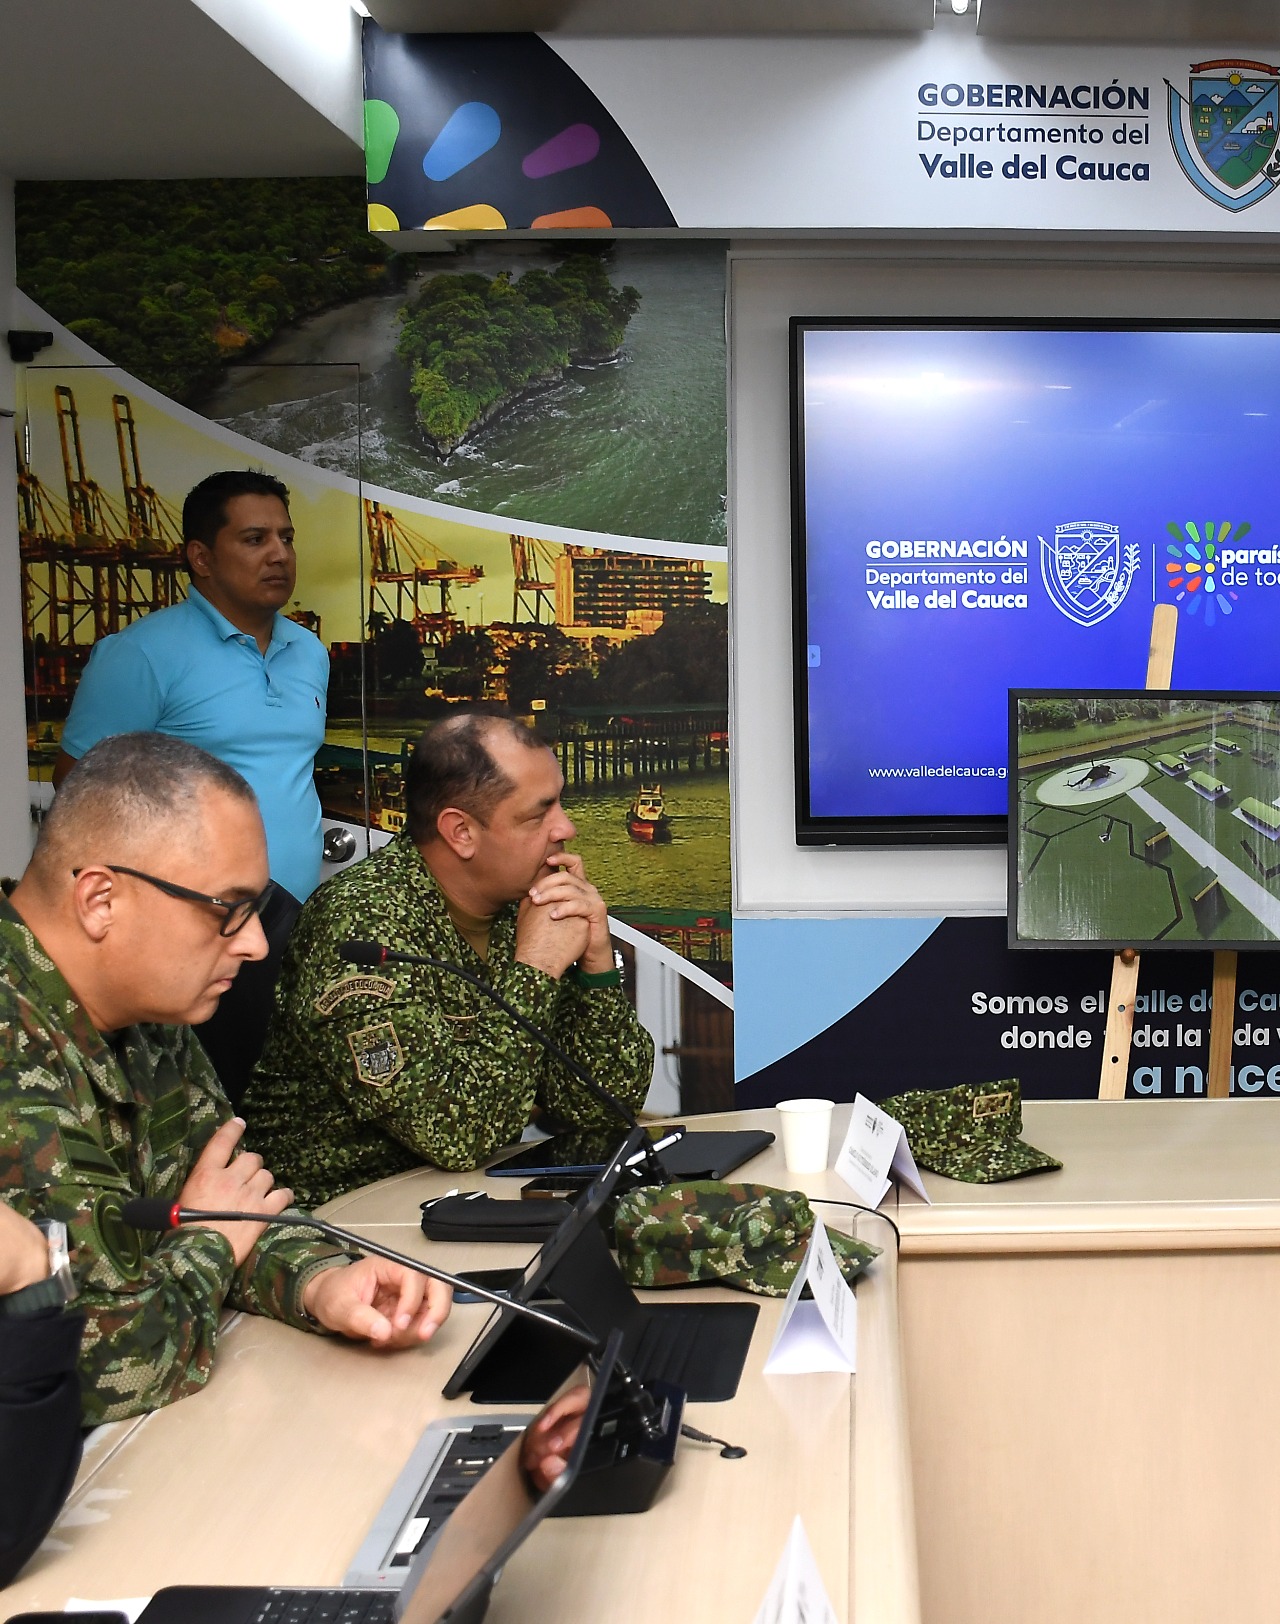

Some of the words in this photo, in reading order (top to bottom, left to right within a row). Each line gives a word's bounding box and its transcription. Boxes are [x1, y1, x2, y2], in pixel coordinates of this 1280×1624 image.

[918, 79, 1149, 111] GOBERNACIÓN
[918, 120, 1102, 146] Departamento
[1112, 122, 1150, 145] del
[919, 153, 994, 180] Valle
[1001, 154, 1047, 181] del
[1055, 155, 1150, 182] Cauca
[865, 535, 1028, 559] GOBERNACIÓN
[865, 569, 996, 587] Departamento
[1001, 567, 1028, 584] del
[1221, 566, 1249, 586] de
[866, 590, 920, 610] Valle
[924, 589, 958, 609] del
[961, 590, 1028, 609] Cauca
[868, 765, 1008, 779] www.valledelcauca.g
[971, 991, 1068, 1015] Somos
[1080, 990, 1105, 1014] el
[1118, 989, 1183, 1013] alle
[1001, 1024, 1092, 1049] donde
[1176, 1024, 1202, 1047] la
[1132, 1066, 1162, 1095] a
